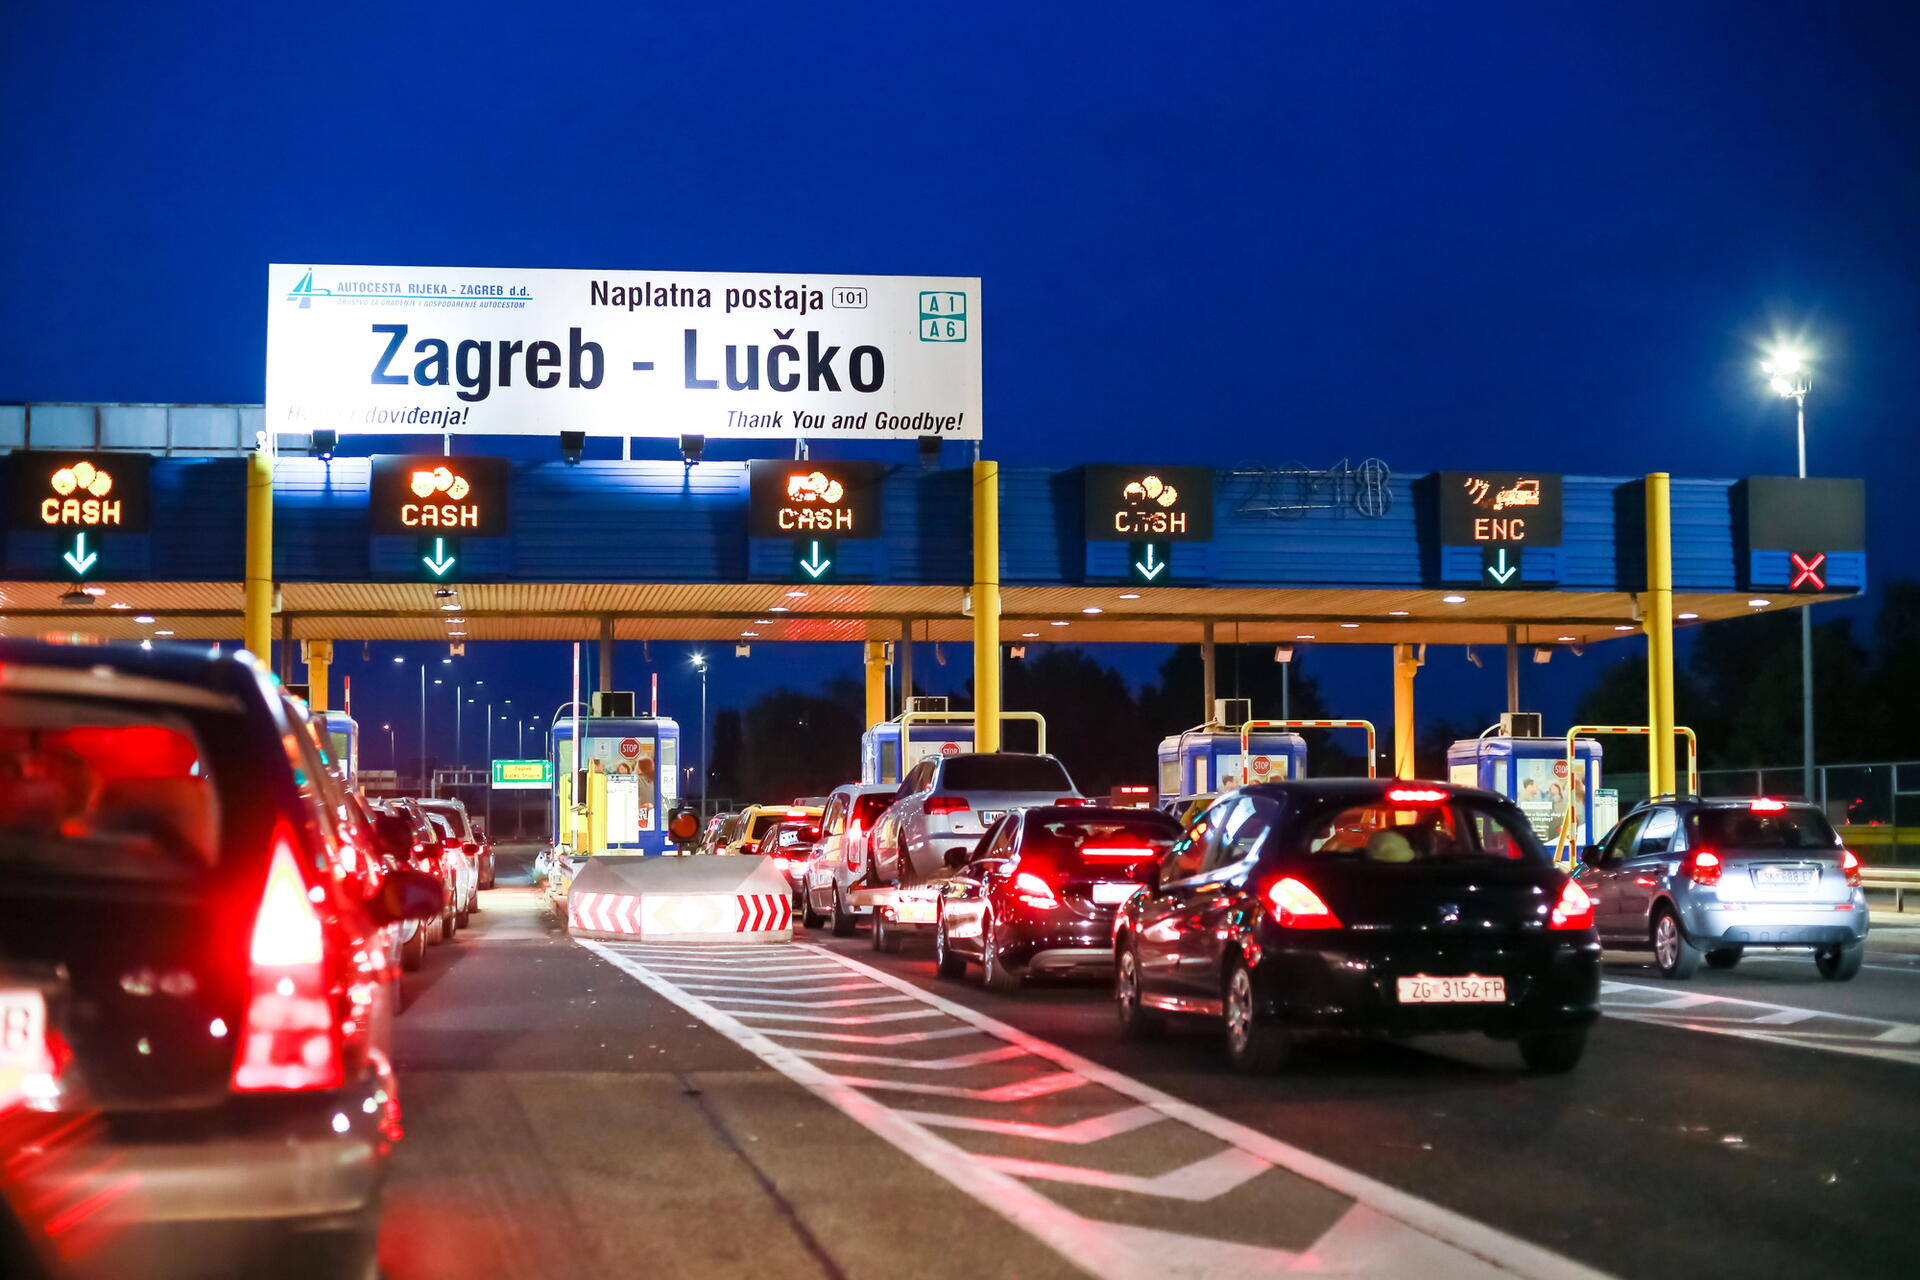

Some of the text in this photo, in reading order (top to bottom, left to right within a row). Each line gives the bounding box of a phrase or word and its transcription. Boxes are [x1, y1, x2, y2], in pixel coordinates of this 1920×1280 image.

[337, 282, 402, 293] AUTOCESTA
[408, 283, 448, 295] RIJEKA
[459, 285, 504, 296] ZAGREB
[509, 286, 530, 297] d.d.
[838, 291, 863, 304] 101
[479, 301, 526, 309] AUTOCESTOM
[590, 281, 824, 316] Naplatna postaja
[929, 295, 954, 312] A 1
[930, 321, 955, 337] A 6
[371, 324, 885, 402] Zagreb - Lučko
[727, 410, 964, 435] Thank You and Goodbye!
[41, 499, 122, 525] CASH
[401, 503, 478, 527] CASH
[778, 508, 852, 530] CASH
[1474, 518, 1525, 540] ENC
[622, 743, 638, 753] STOP
[1254, 761, 1269, 770] STOP
[1411, 982, 1431, 998] ZG
